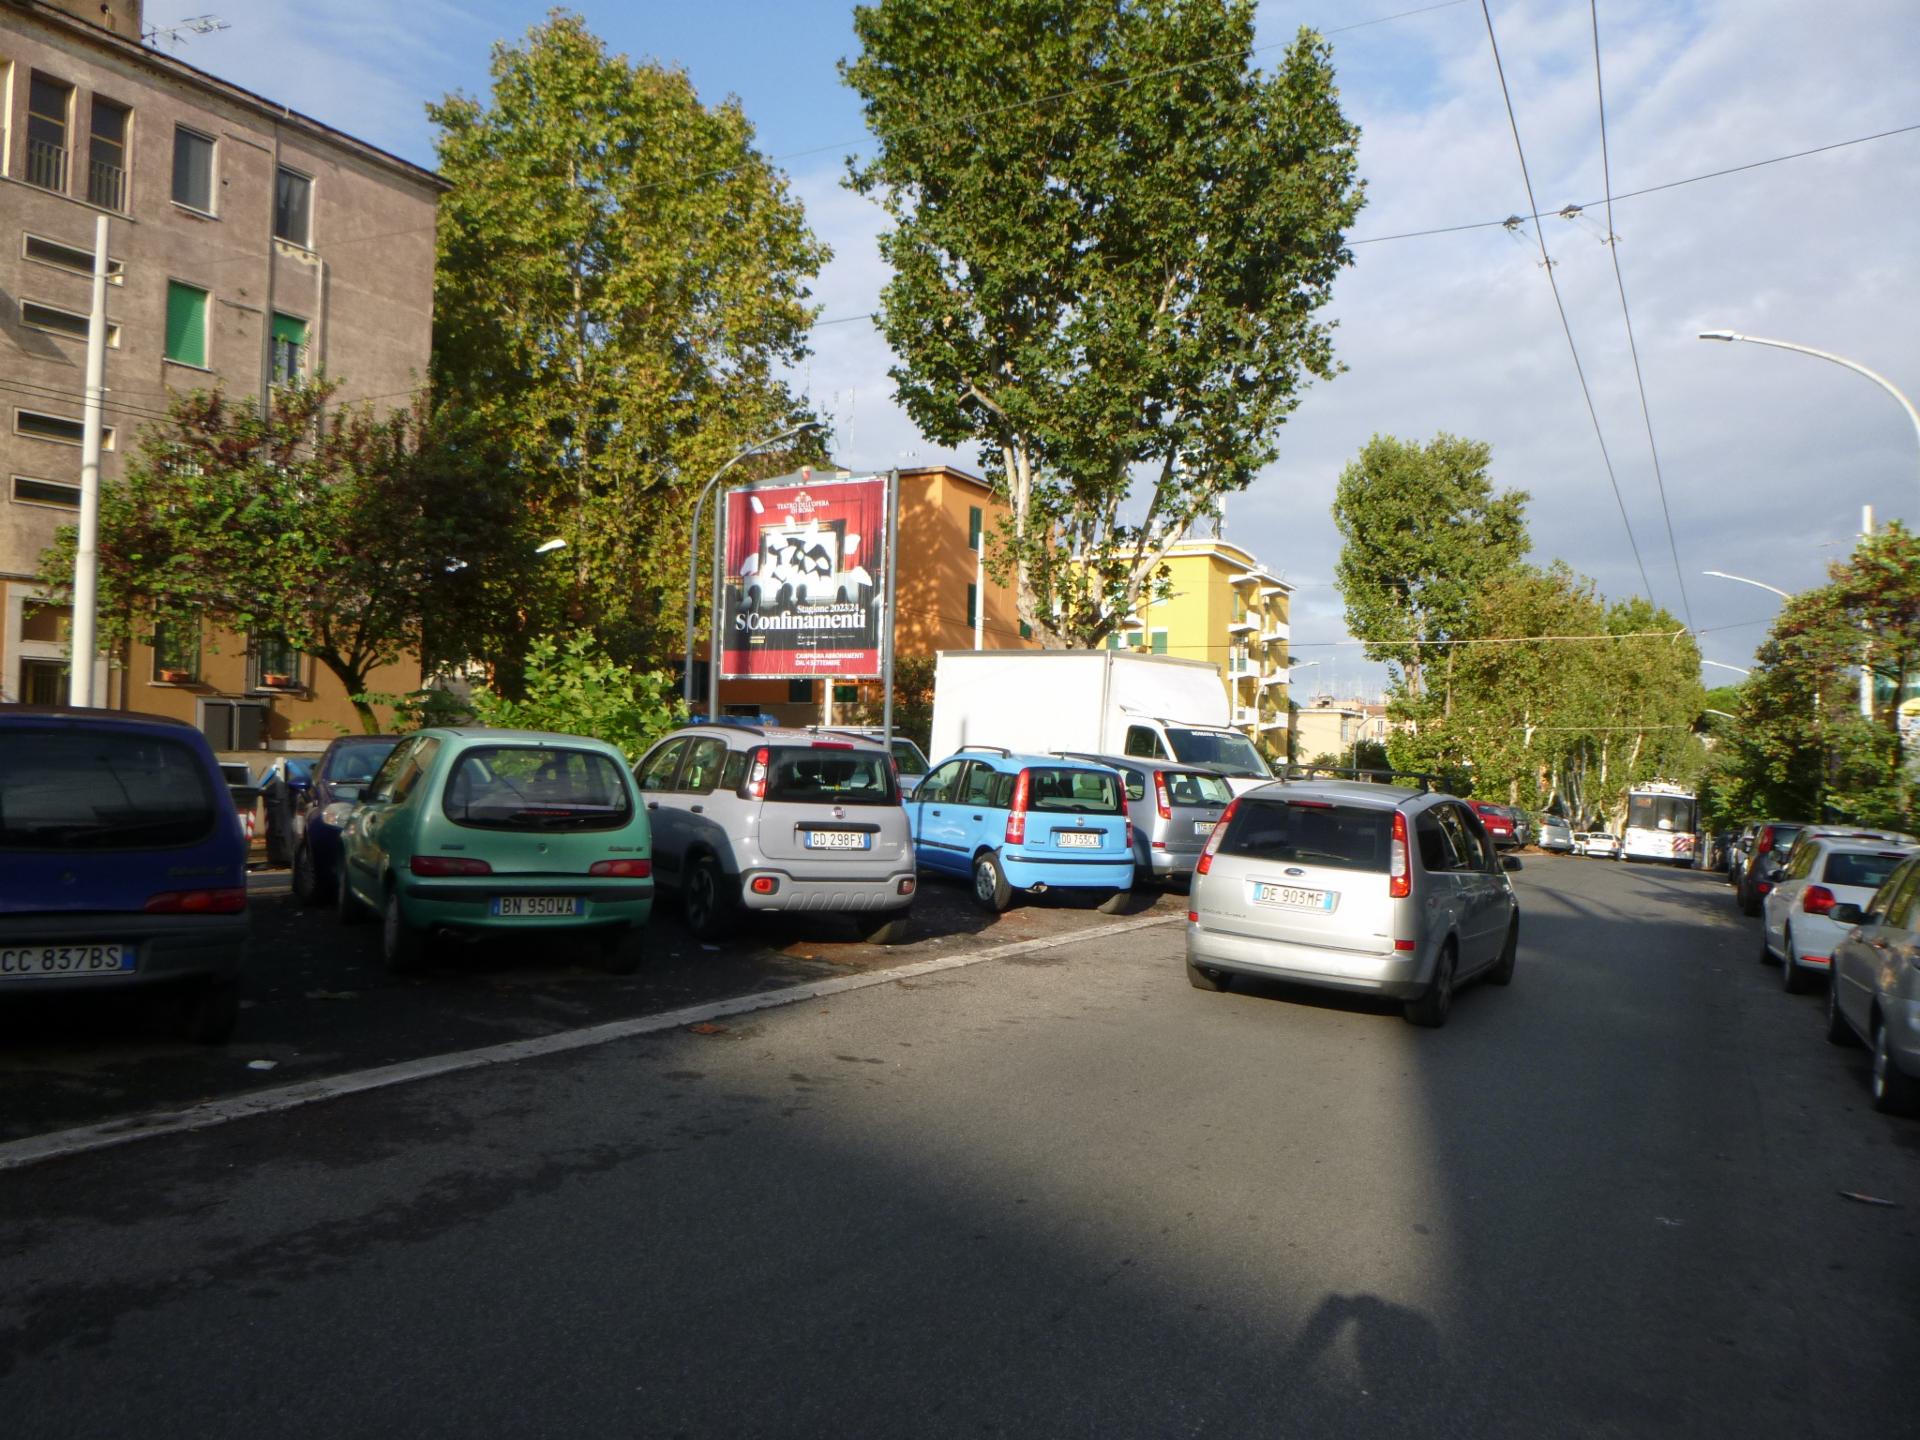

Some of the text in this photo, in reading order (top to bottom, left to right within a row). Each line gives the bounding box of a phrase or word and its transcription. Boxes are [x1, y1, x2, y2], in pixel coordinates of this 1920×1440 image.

[797, 604, 829, 614] Stagione
[813, 833, 863, 846] GD 298FX
[1261, 887, 1324, 907] DE 903MF
[502, 899, 574, 914] BN 950WA
[2, 947, 119, 972] CC 837BS
